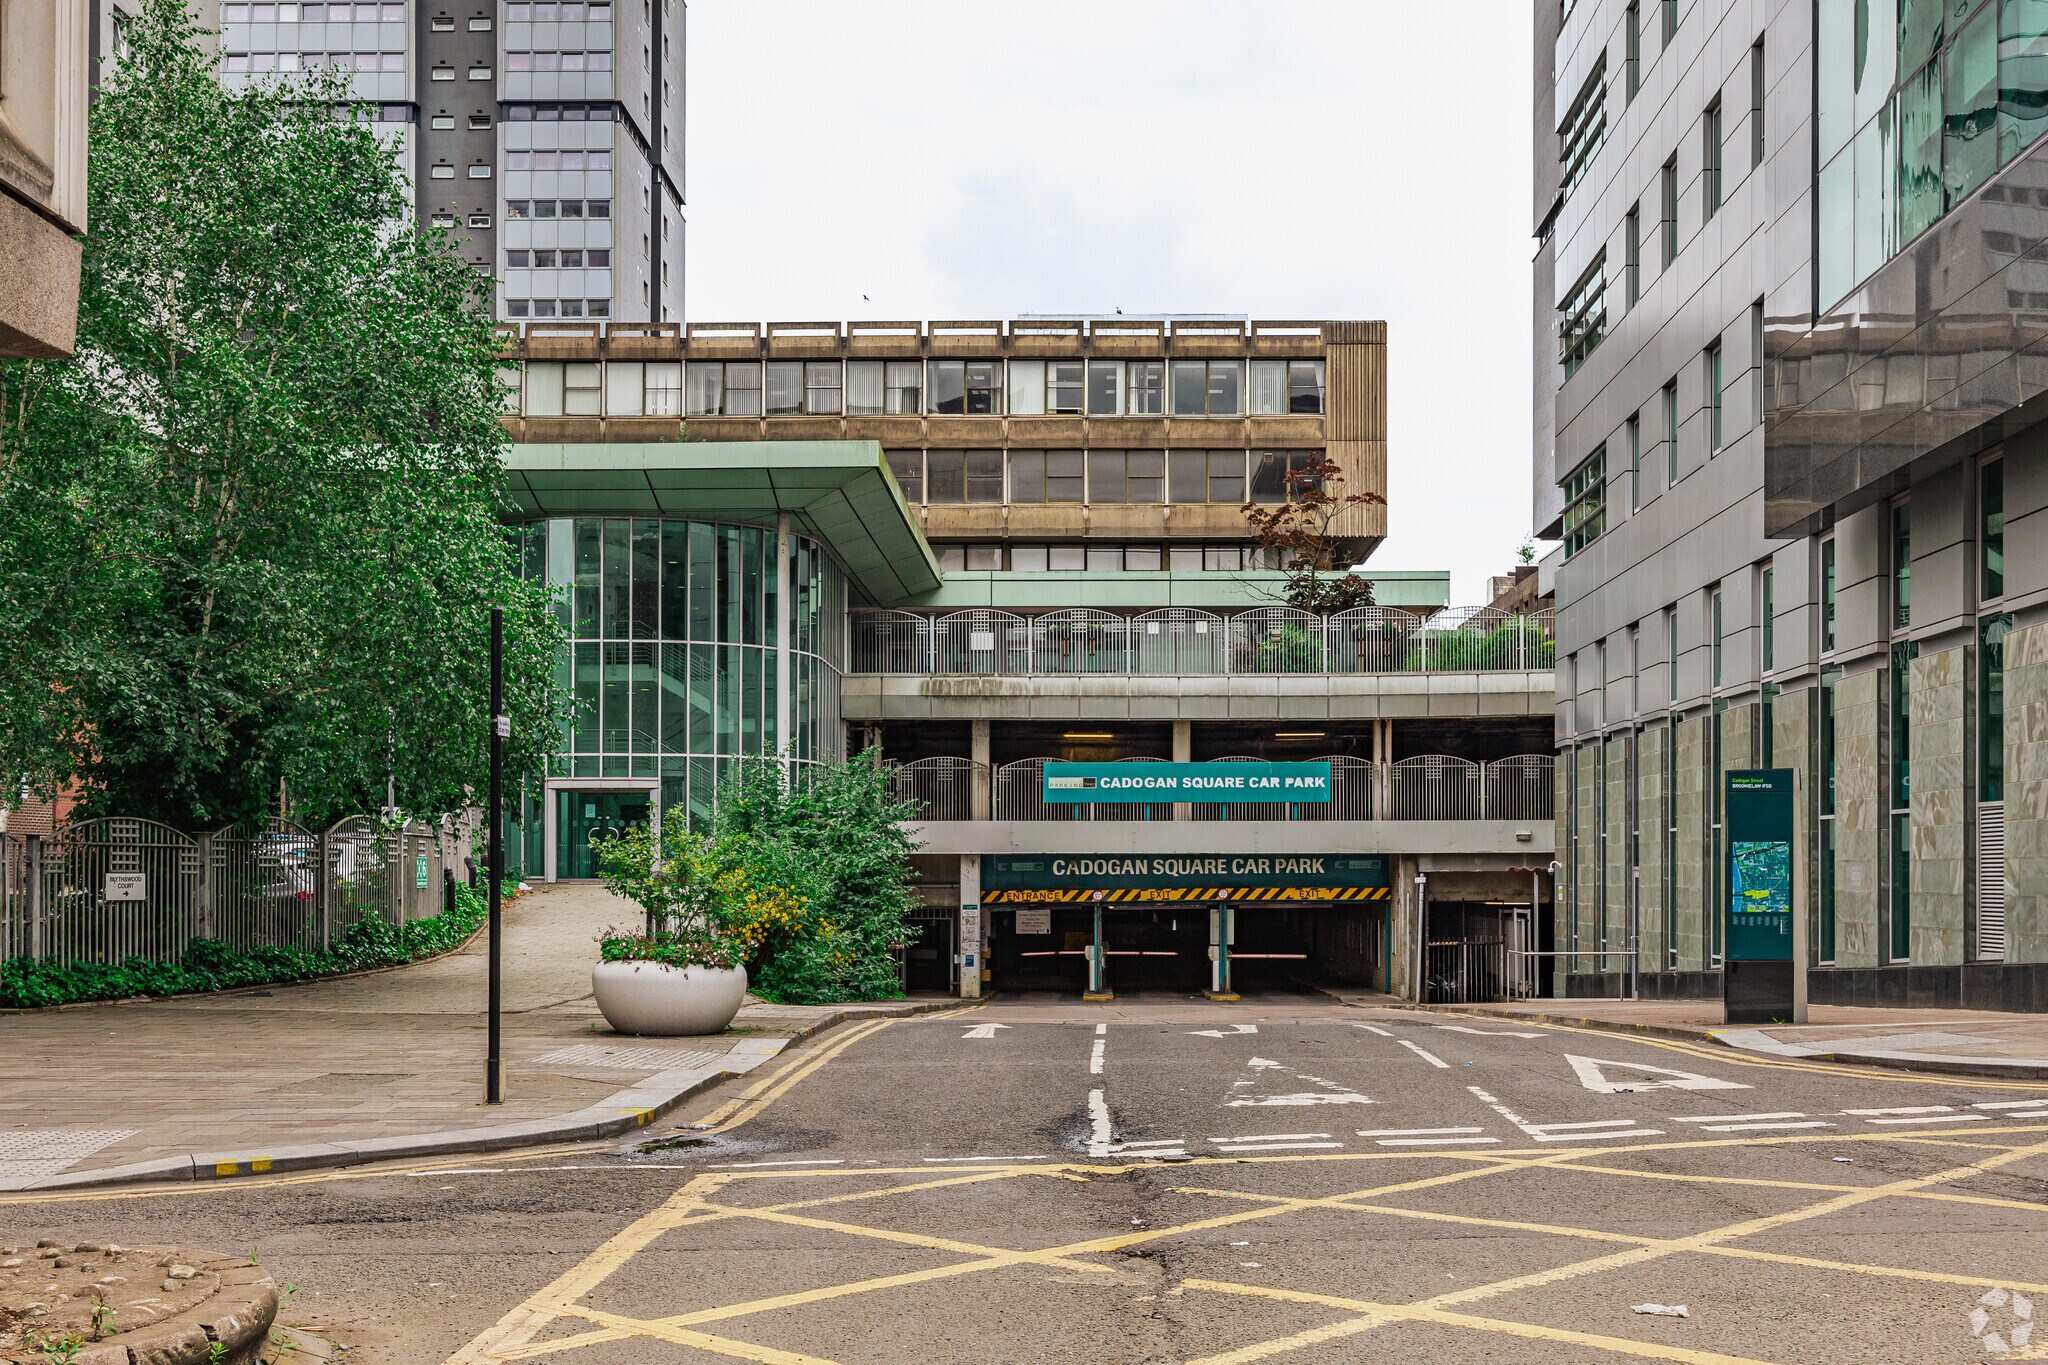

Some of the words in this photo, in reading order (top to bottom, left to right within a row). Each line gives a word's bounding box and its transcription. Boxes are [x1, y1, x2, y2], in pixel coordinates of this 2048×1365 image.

[1100, 777, 1177, 788] CADOGAN
[1182, 777, 1245, 789] SQUARE
[1248, 777, 1280, 788] CAR
[1285, 777, 1325, 788] PARK
[1052, 859, 1148, 876] CADOGAN
[1152, 859, 1227, 877] SQUARE
[1232, 858, 1270, 875] CAR
[1275, 858, 1324, 875] PARK
[1006, 892, 1060, 900] ENTRANCE
[1150, 891, 1171, 899] EXIT
[1299, 890, 1320, 898] EXIT
